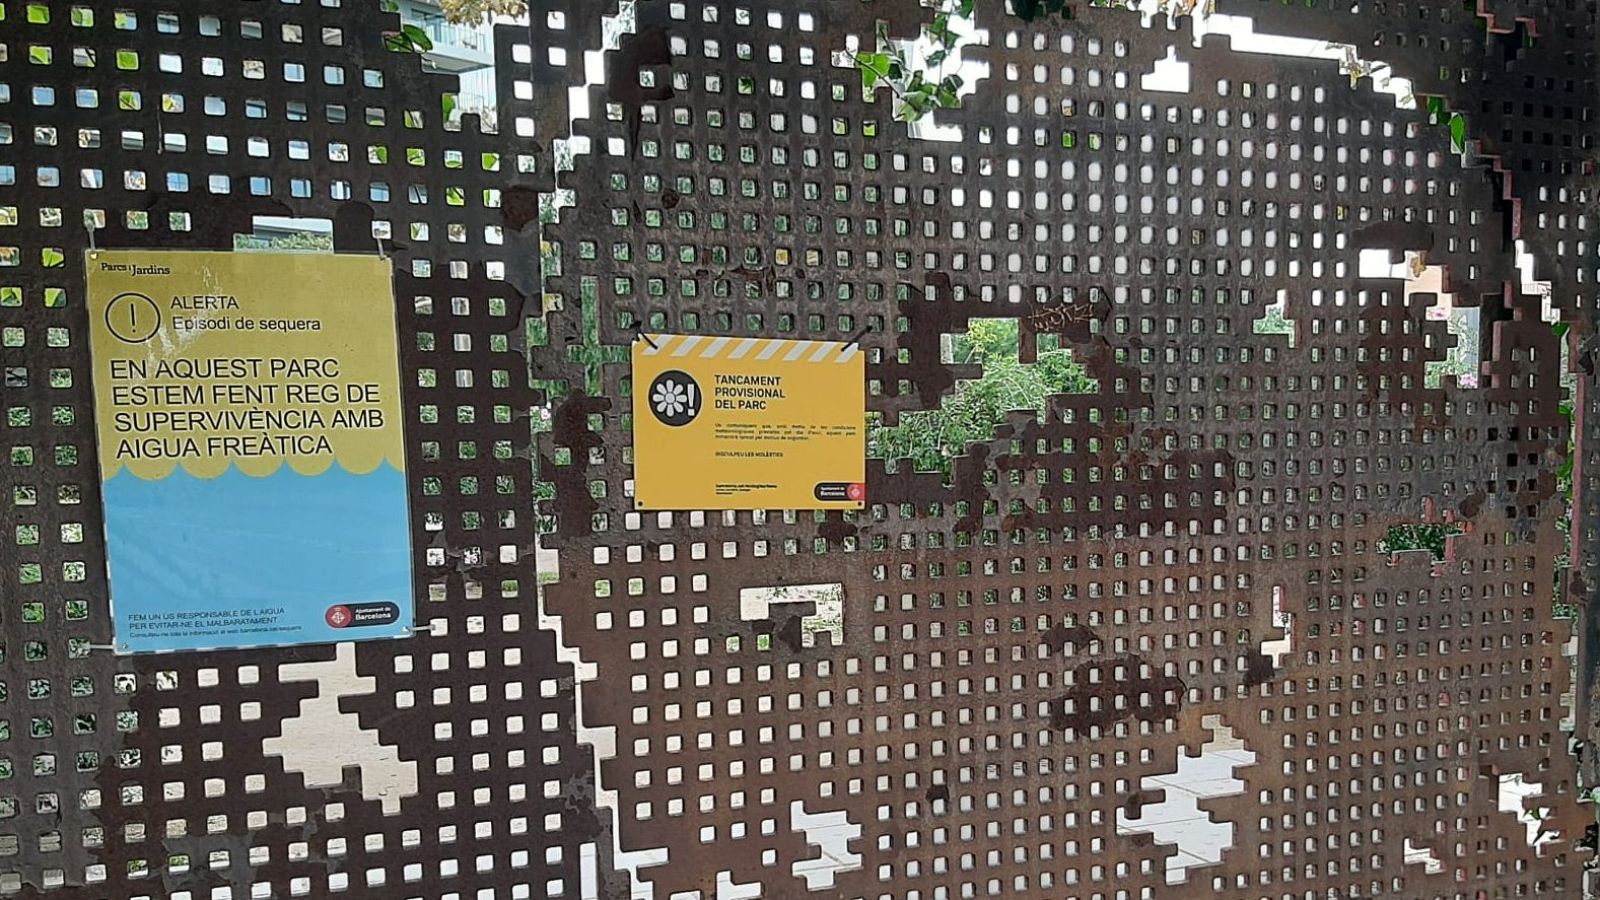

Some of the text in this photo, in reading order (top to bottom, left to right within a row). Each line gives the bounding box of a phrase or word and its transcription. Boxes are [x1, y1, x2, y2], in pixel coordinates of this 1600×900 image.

[101, 262, 127, 271] Parcs
[132, 264, 170, 277] Jardins
[170, 295, 239, 310] ALERTA
[173, 315, 321, 333] Episodi de sequera
[111, 358, 339, 379] EN AQUEST PARC
[714, 374, 782, 386] TANCAMENT
[113, 384, 380, 405] ESTEM FENT REG DE
[715, 387, 786, 399] PROVISIONAL
[715, 399, 767, 410] DEL PARC
[115, 406, 384, 432] SUPERVIVÈNCIA AMB
[116, 431, 332, 459] AIGUA FREÀTICA
[128, 613, 147, 621] FEM
[148, 613, 162, 621] UN
[176, 610, 239, 620] RESPONSABLE
[241, 609, 252, 617] DE
[355, 612, 392, 621] Barcelona
[129, 616, 278, 630] PER EVITAR-NE EL MALBARATAMENT
